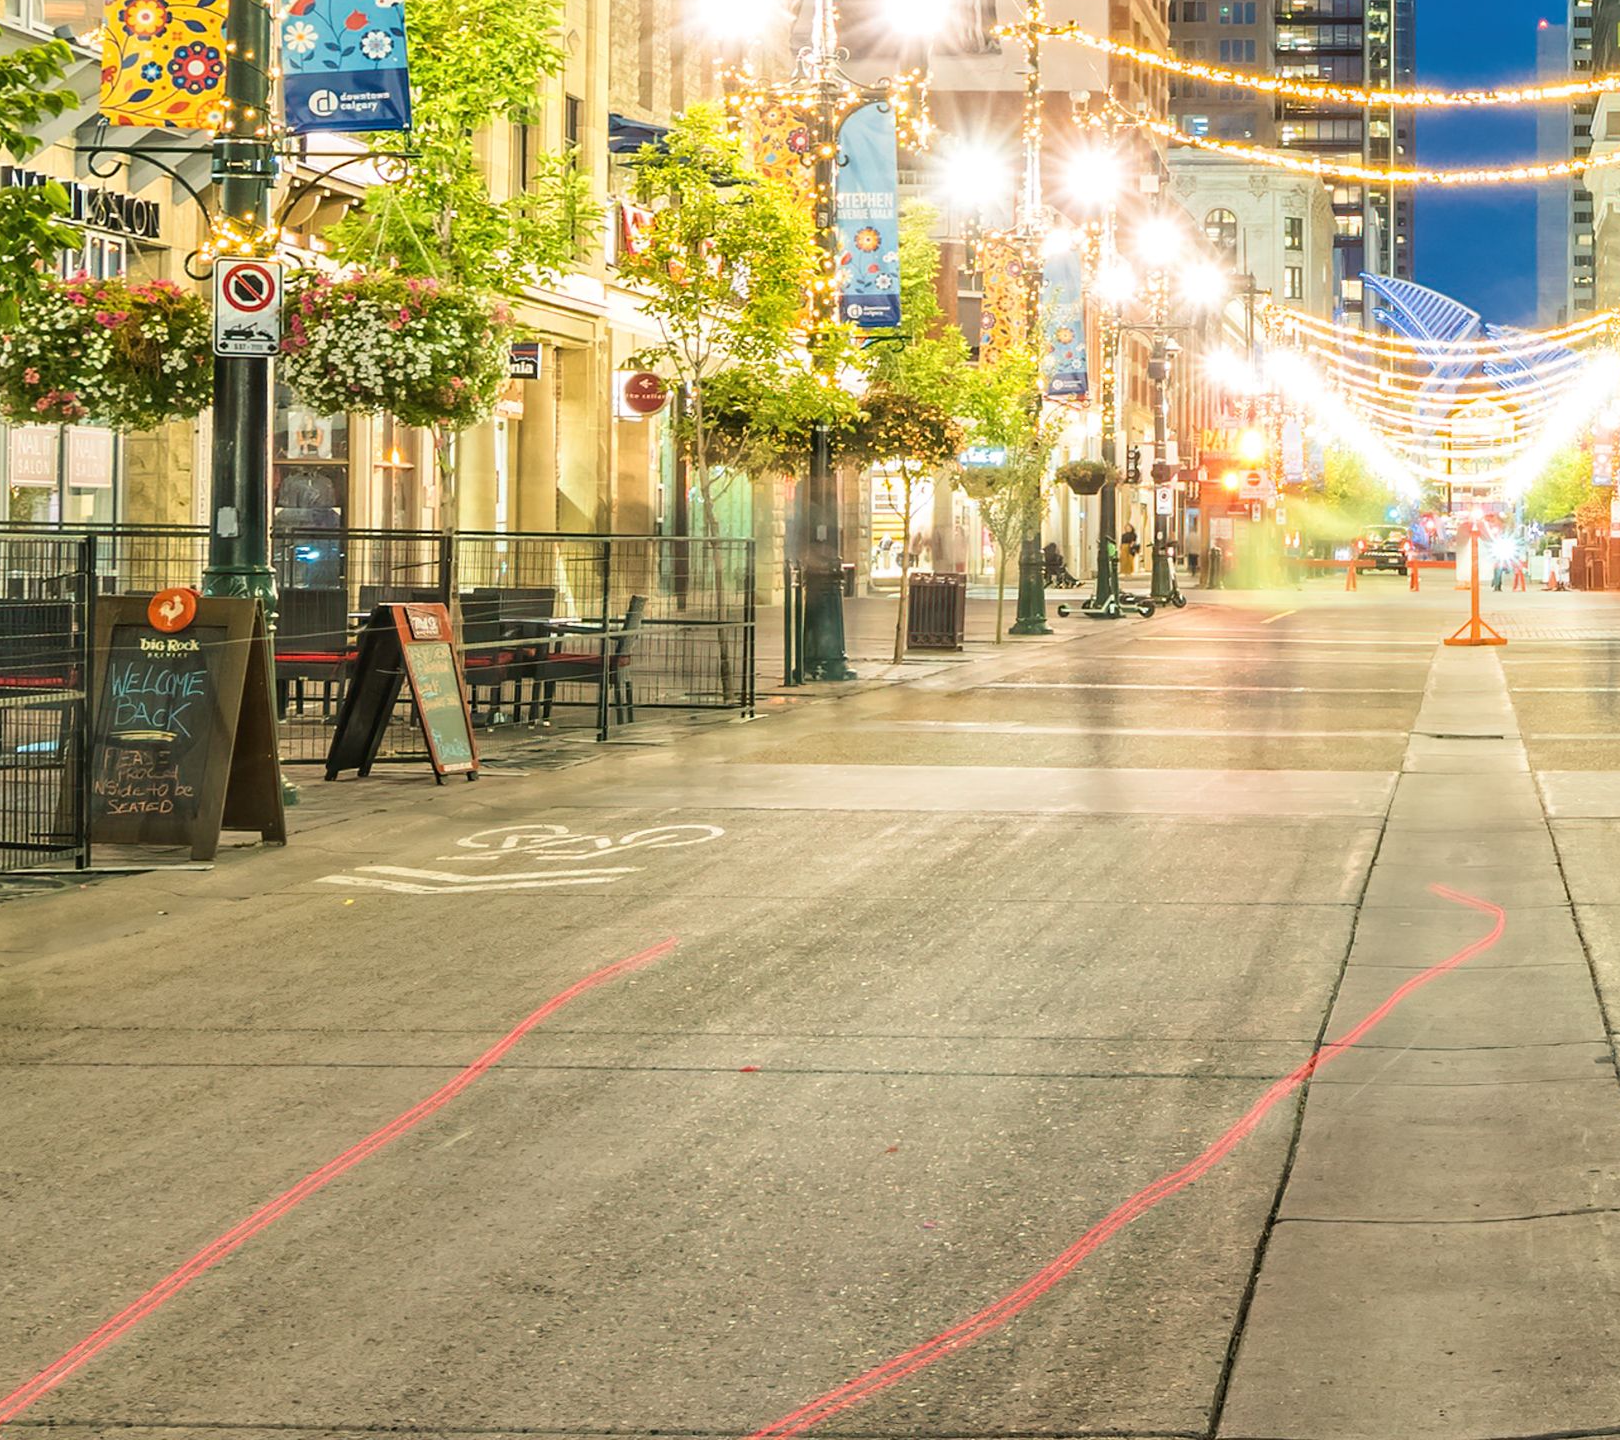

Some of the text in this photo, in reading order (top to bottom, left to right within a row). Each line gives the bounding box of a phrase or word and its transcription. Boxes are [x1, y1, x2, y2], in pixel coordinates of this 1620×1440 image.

[340, 91, 390, 101] downtown
[340, 101, 378, 113] calgary
[18, 432, 42, 456] NAIL
[18, 459, 51, 475] SALON
[167, 638, 201, 652] Rock
[111, 661, 208, 698] WELCOME
[114, 697, 192, 739] BACK
[106, 798, 175, 815] SEATED
